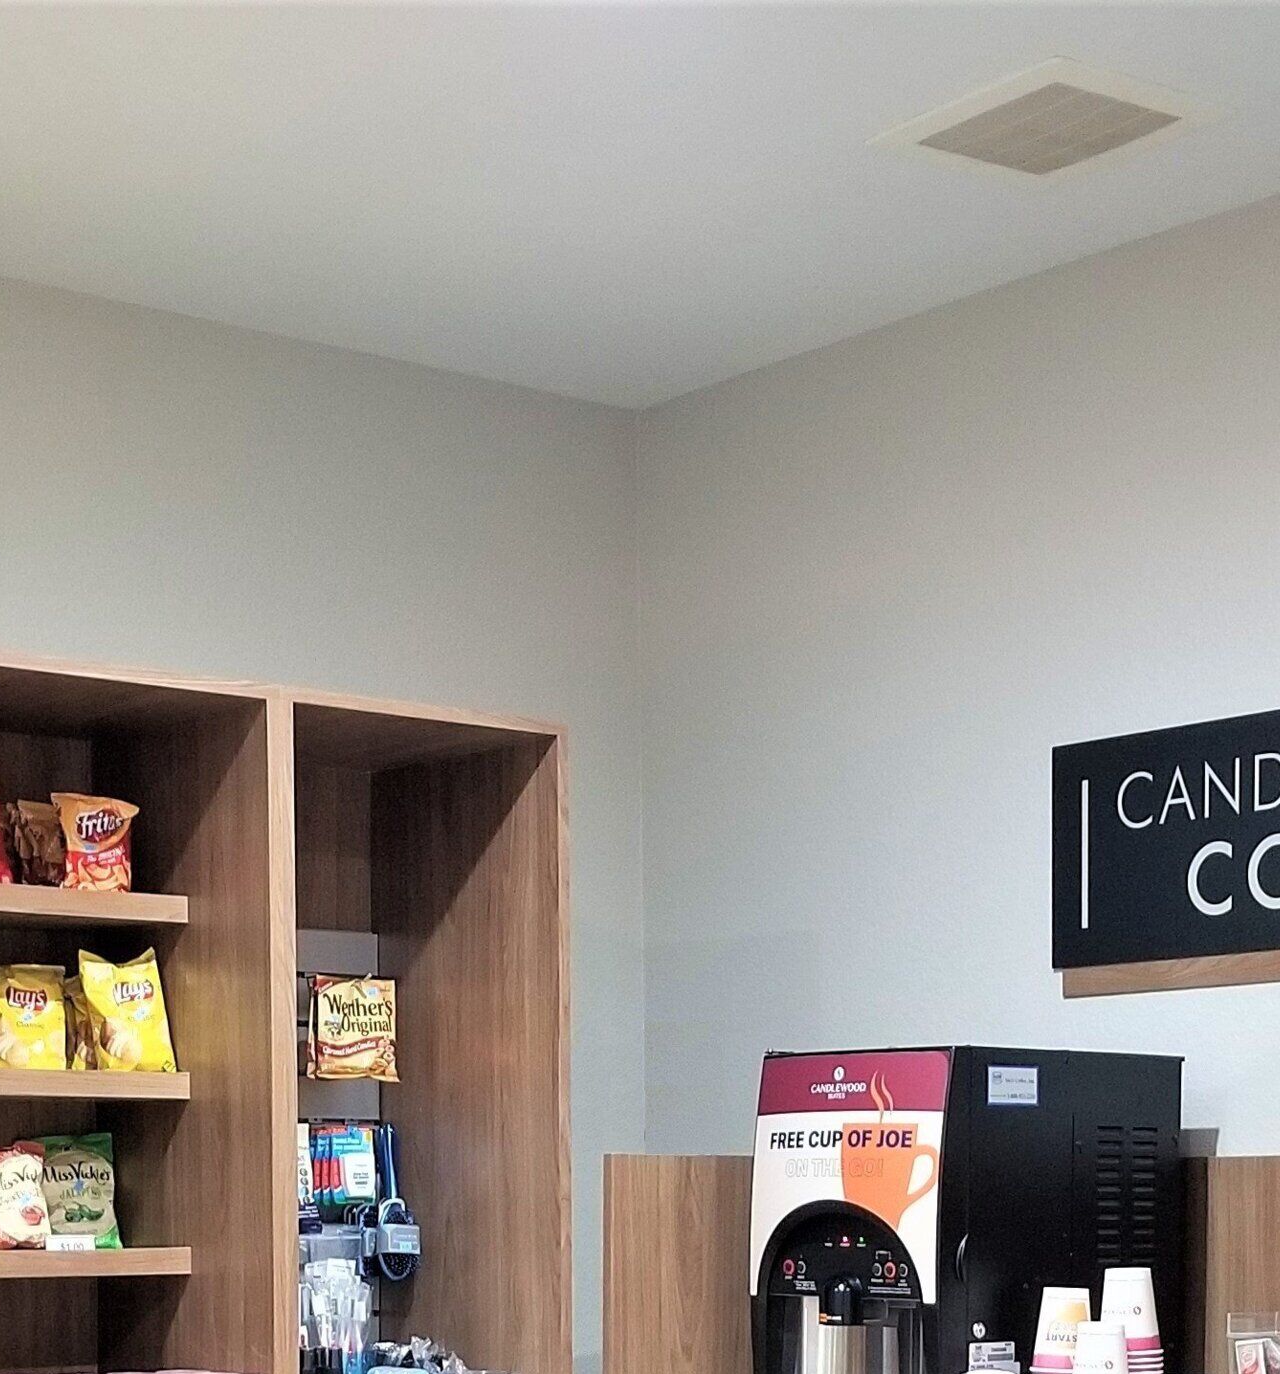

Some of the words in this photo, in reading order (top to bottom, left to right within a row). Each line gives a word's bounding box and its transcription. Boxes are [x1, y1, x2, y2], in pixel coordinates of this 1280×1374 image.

[323, 993, 393, 1017] Werther's
[341, 1013, 392, 1036] Original
[811, 1083, 866, 1094] CANDLEWOOD
[770, 1131, 805, 1149] FREE
[809, 1130, 843, 1148] CUP
[848, 1130, 872, 1147] OF
[876, 1130, 913, 1147] JOE
[785, 1158, 808, 1177] ON
[811, 1158, 844, 1177] THE
